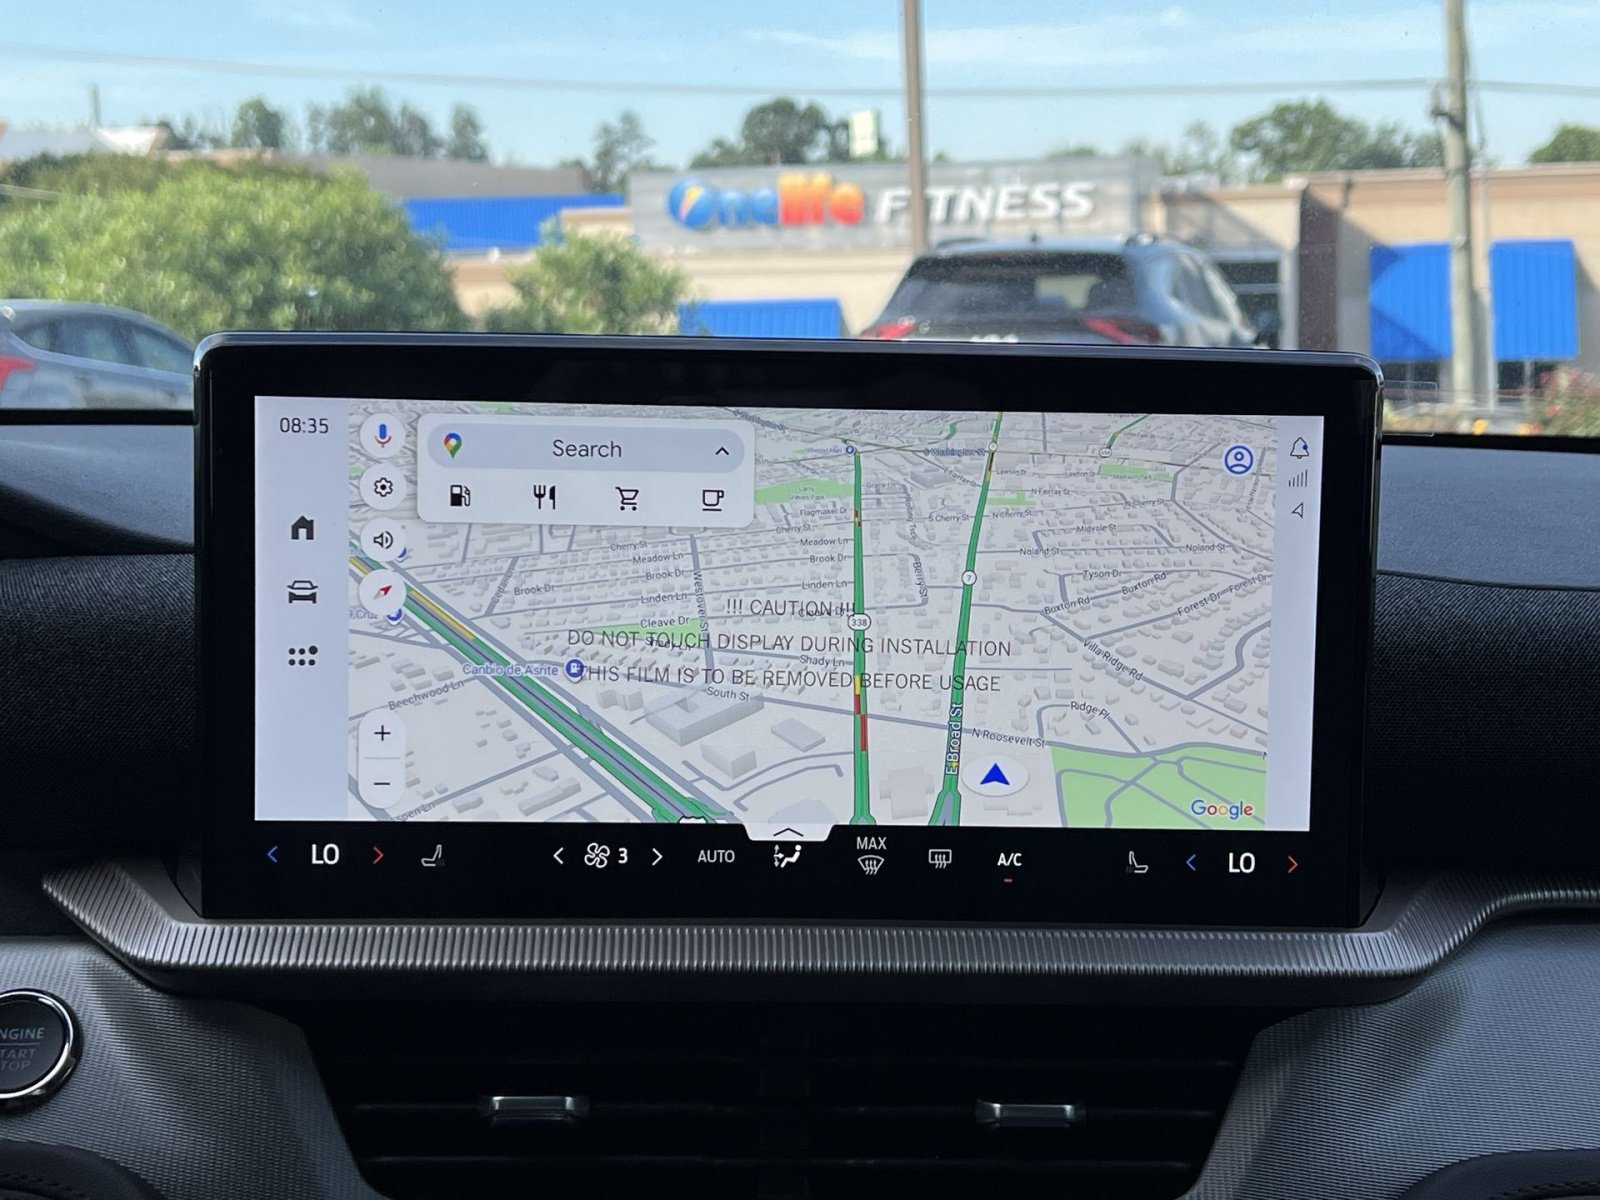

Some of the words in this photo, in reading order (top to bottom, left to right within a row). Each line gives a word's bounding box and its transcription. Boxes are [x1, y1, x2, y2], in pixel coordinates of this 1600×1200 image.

[875, 181, 1095, 223] FTNESS
[279, 417, 329, 434] 08:35
[552, 439, 623, 458] Search
[1132, 499, 1155, 507] Cherry
[800, 508, 838, 517] Flagmaker
[928, 514, 934, 522] S
[935, 514, 961, 523] Cherry
[999, 510, 1023, 519] Cherry
[776, 525, 800, 534] Cherry
[1076, 525, 1106, 533] Midvale
[1107, 523, 1116, 531] St
[610, 542, 636, 551] Cherry
[638, 540, 648, 549] St
[800, 538, 835, 547] Meadow
[1185, 543, 1214, 552] Noland
[632, 553, 670, 564] Meadow
[673, 552, 684, 560] Ln
[809, 554, 835, 563] Brook
[837, 554, 847, 562] Dr
[1019, 547, 1050, 556] Noland
[645, 571, 672, 580] Brook
[674, 569, 685, 578] Dr
[912, 561, 925, 587] Berry
[1083, 570, 1110, 582] Tyson
[1111, 569, 1122, 578] Dr
[514, 585, 541, 596] Brook
[544, 583, 556, 592] Dr
[802, 581, 834, 590] Linden
[836, 581, 848, 589] Ln
[1121, 578, 1152, 595] Buxton
[1153, 572, 1167, 582] Rd
[1228, 577, 1253, 594] Forest
[1253, 573, 1268, 585] Dr
[641, 594, 674, 604] Linden
[676, 592, 688, 601] Ln
[918, 586, 928, 602] St
[692, 570, 706, 620] Westover
[699, 620, 709, 635] St
[726, 598, 743, 615] !!!
[750, 599, 832, 617] CAUTION
[1044, 600, 1076, 615] Buxton
[1077, 596, 1091, 606] Rd
[1177, 598, 1207, 616] Forest
[1207, 592, 1222, 603] Dr
[640, 619, 675, 629] Cleave
[678, 616, 690, 625] Dr
[850, 618, 868, 627] 338
[568, 630, 594, 646] DO
[602, 630, 639, 647] NOT
[645, 631, 710, 648] TOUCH
[718, 633, 794, 651] DISPLAY
[801, 635, 874, 653] DURING
[881, 638, 1011, 658] INSTALLATION
[800, 655, 830, 667] Shady
[833, 655, 845, 666] Ln
[1083, 638, 1103, 657] Villa
[1103, 652, 1129, 673] Ridge
[1129, 667, 1144, 681] Rd
[463, 664, 501, 675] Canbio
[504, 664, 520, 675] de
[525, 663, 559, 675] Asrite
[578, 665, 619, 682] THIS
[627, 666, 669, 684] FILM
[678, 667, 694, 684] IS
[700, 668, 725, 685] TO
[731, 669, 756, 686] BE
[763, 670, 852, 688] REMOVED
[861, 673, 932, 690] BEFORE
[940, 674, 1001, 692] USAGE
[388, 685, 449, 711] Beechwood
[451, 680, 465, 692] Ln
[706, 686, 737, 700] South
[739, 691, 750, 702] St
[950, 703, 964, 719] St
[1070, 701, 1098, 718] Ridge
[946, 722, 962, 764] Broad
[972, 728, 980, 737] N
[983, 730, 1033, 747] Roosevelt
[1034, 737, 1046, 748] St
[944, 765, 958, 775] E
[422, 800, 435, 813] Ln
[1191, 799, 1254, 821] Google
[856, 836, 887, 850] MAX
[311, 844, 340, 865] LO
[618, 848, 628, 864] 3
[697, 849, 735, 864] AUTO
[997, 853, 1022, 867] A/C
[1227, 853, 1256, 873] LO
